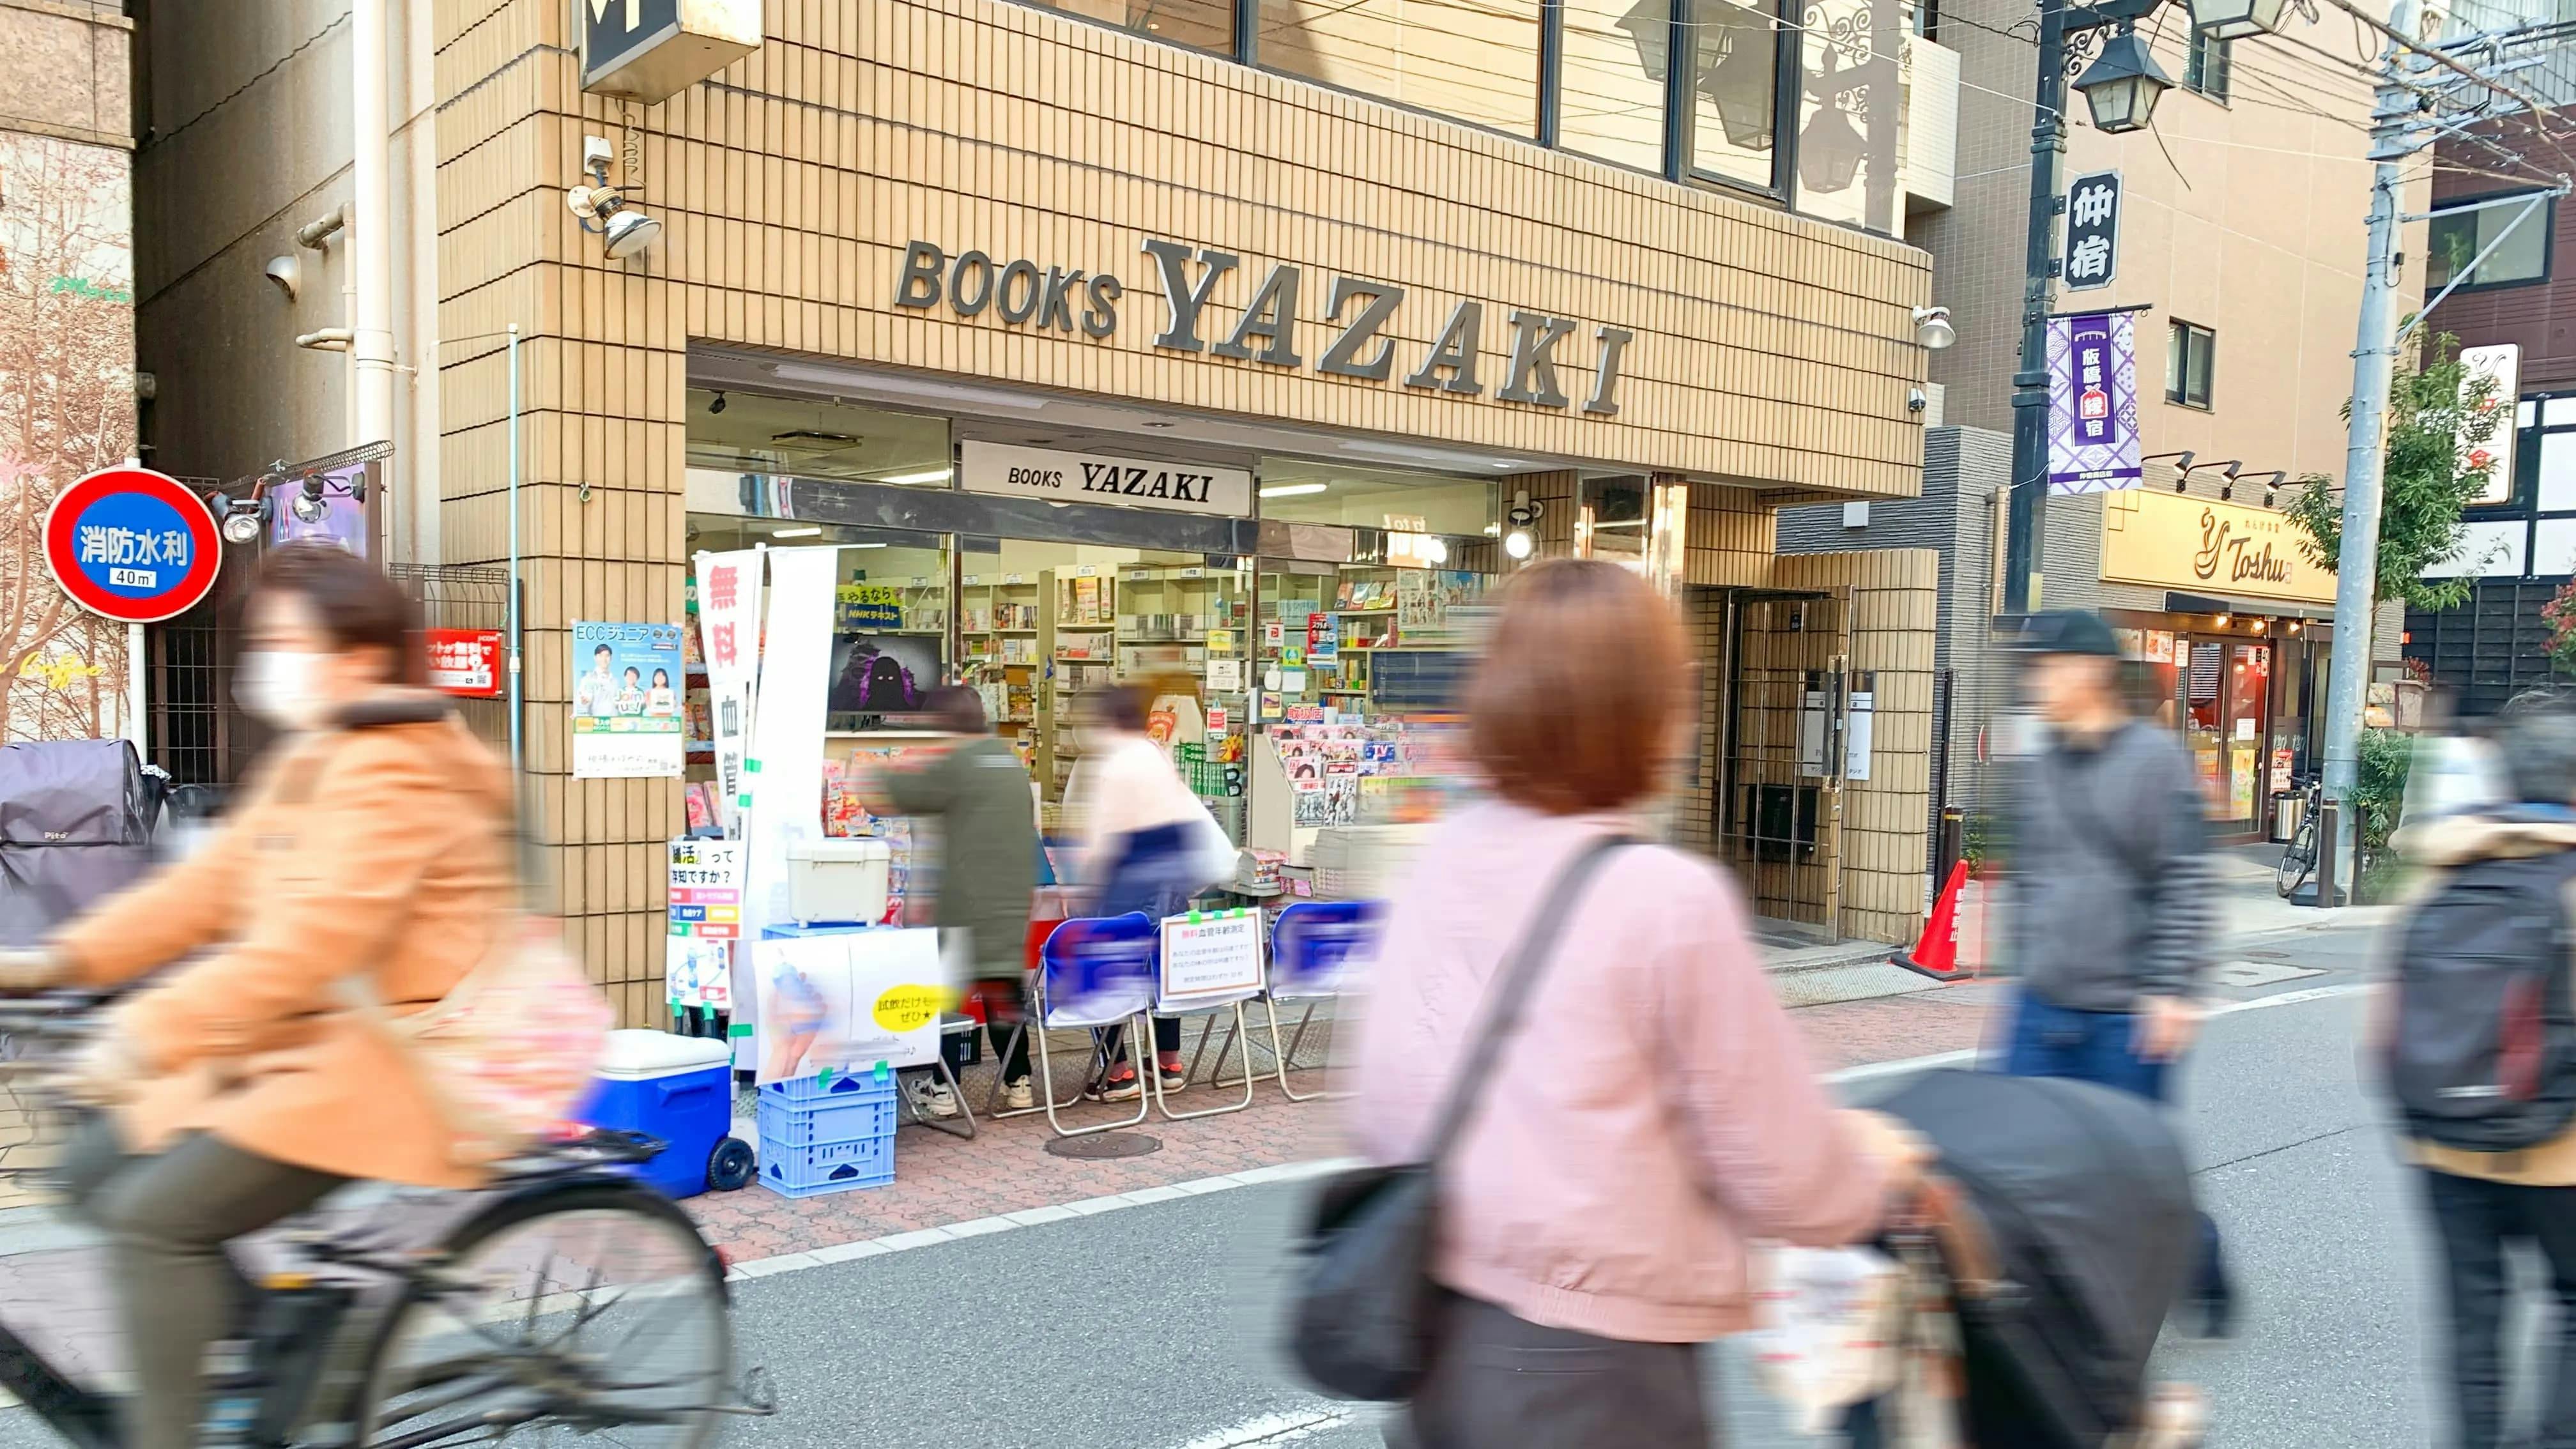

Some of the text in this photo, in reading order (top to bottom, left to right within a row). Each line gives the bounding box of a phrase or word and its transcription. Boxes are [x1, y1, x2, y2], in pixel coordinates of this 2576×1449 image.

[2069, 183, 2115, 279] 仲宿
[895, 238, 1633, 415] BOOKS YAZAKI
[1008, 462, 1214, 503] BOOKS YAZAKI
[80, 525, 187, 566] 消防水利
[2227, 537, 2285, 582] Toshu
